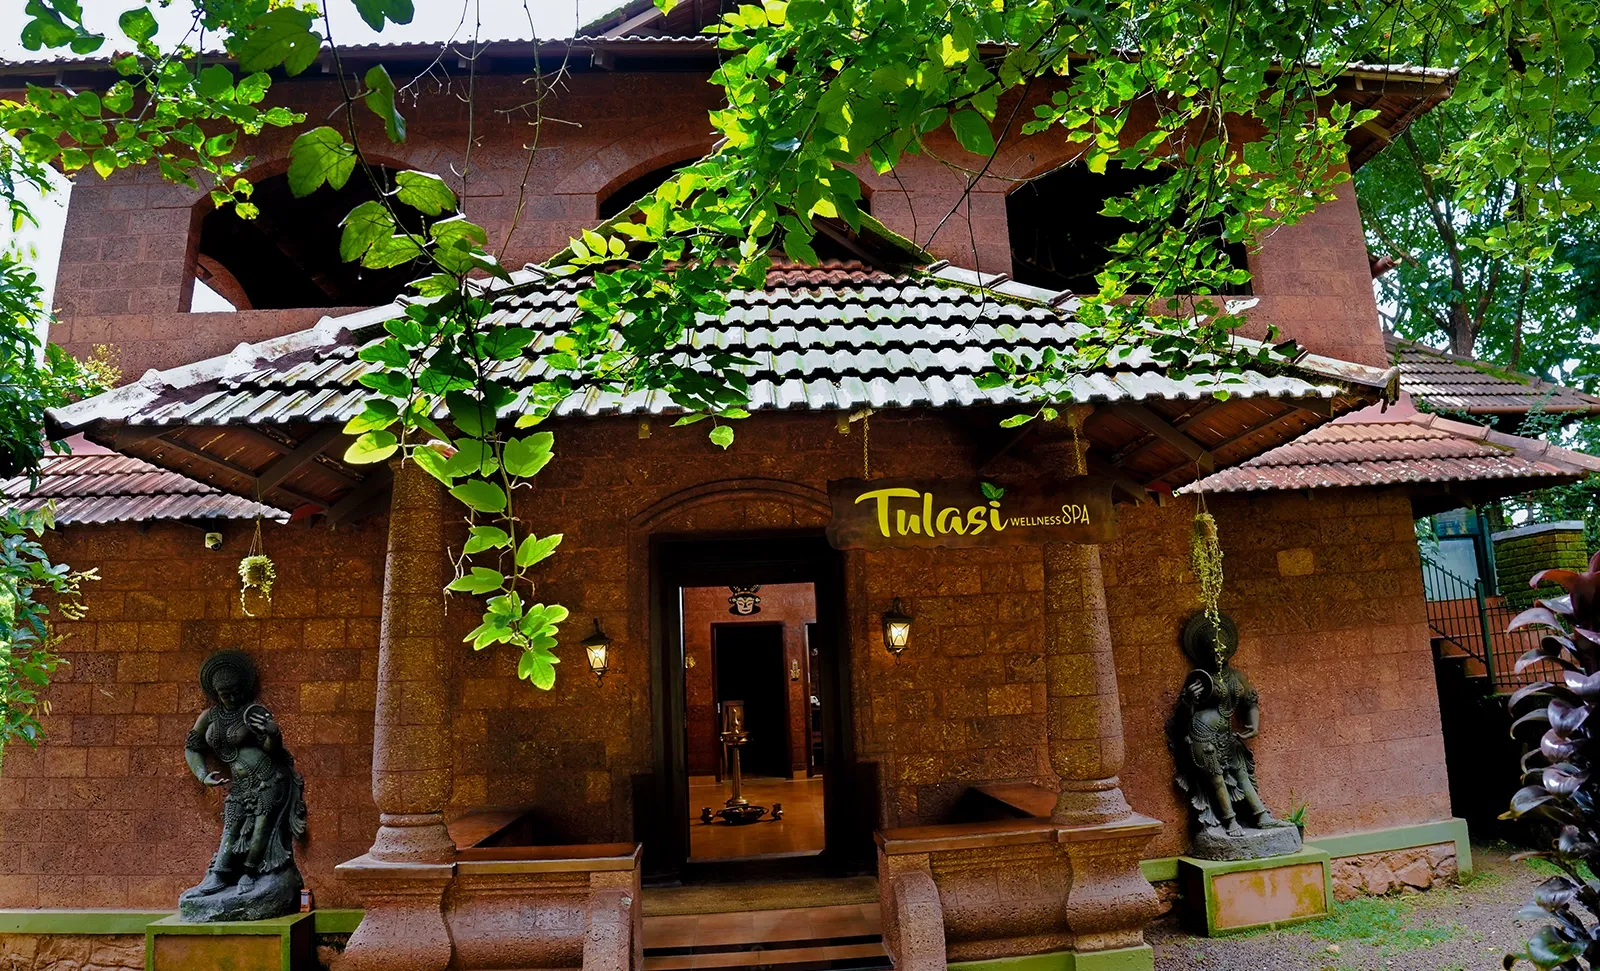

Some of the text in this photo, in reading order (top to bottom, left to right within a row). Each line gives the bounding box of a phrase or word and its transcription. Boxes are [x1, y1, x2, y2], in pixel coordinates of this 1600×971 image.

[855, 487, 1090, 538] Tulasi WELLNESS SPA
